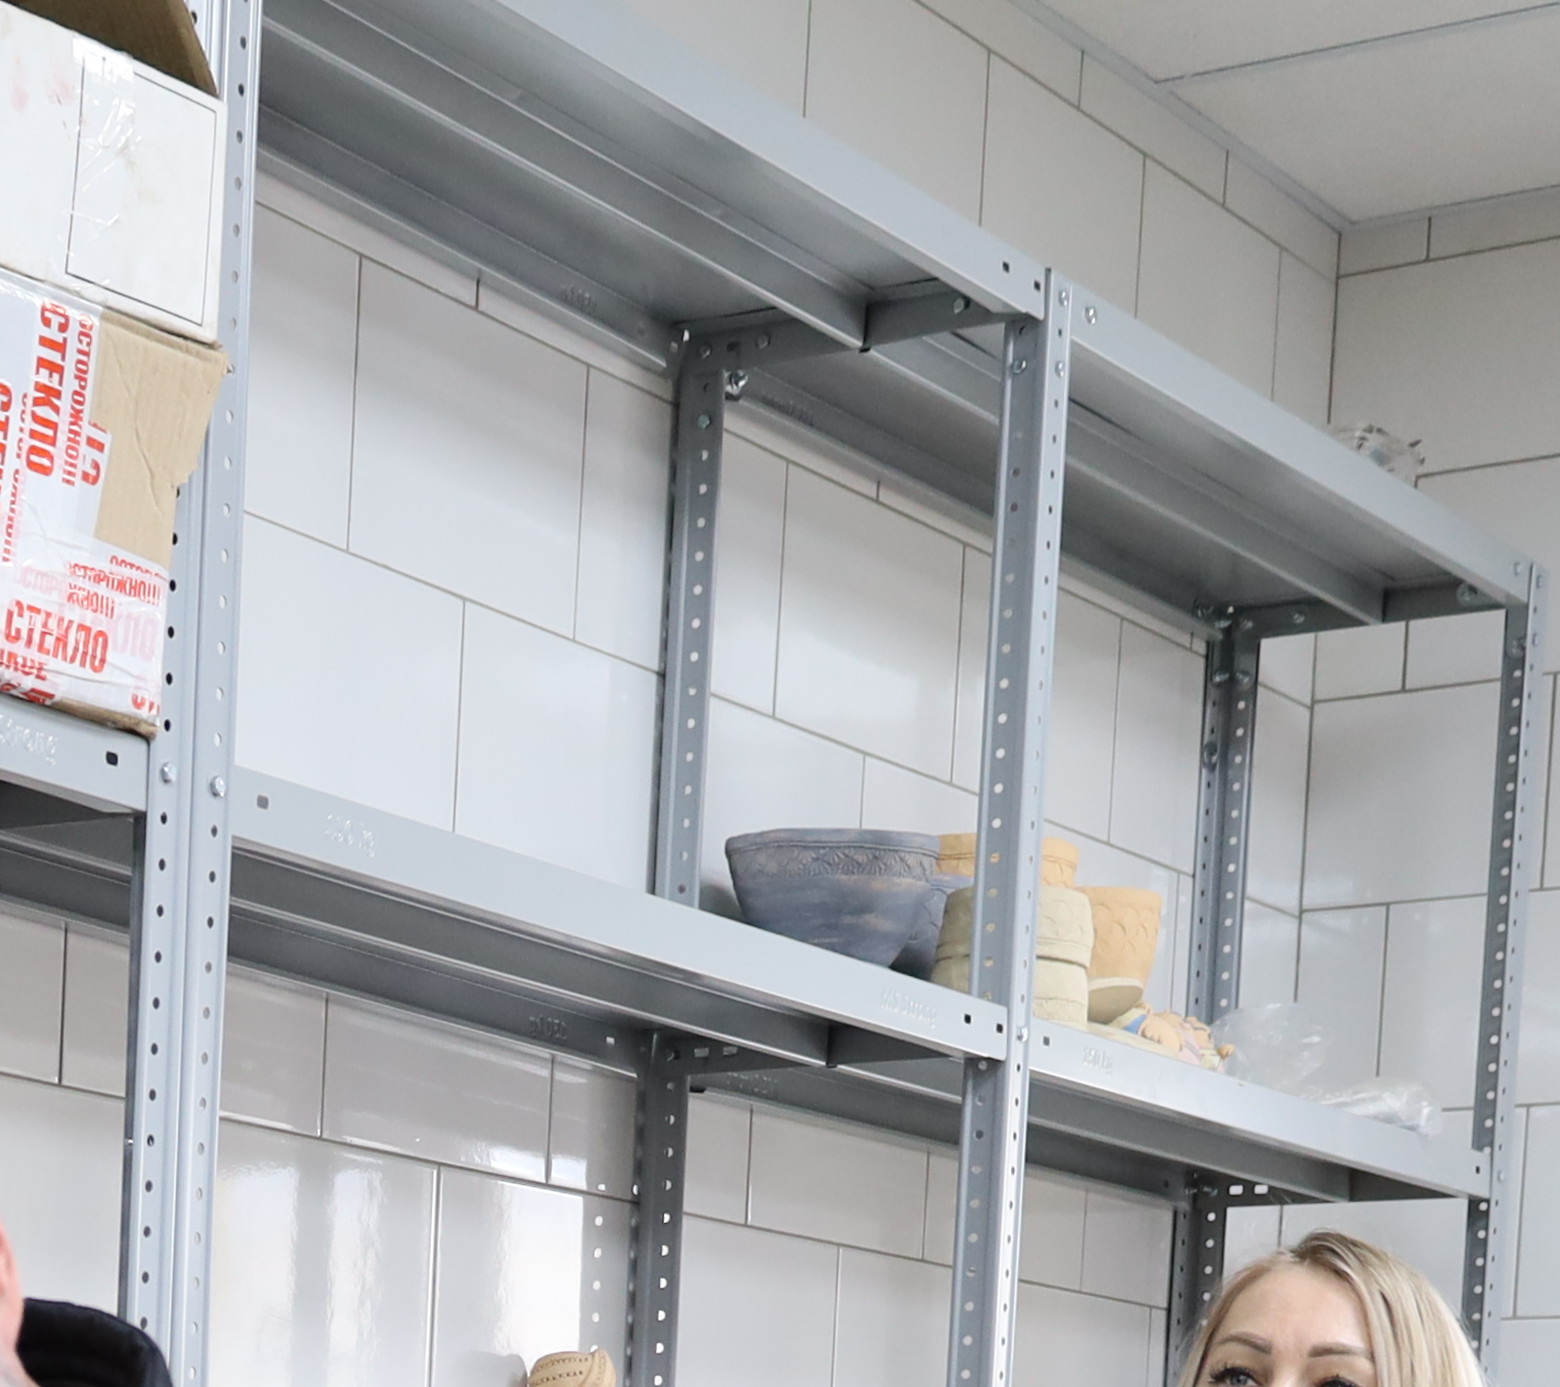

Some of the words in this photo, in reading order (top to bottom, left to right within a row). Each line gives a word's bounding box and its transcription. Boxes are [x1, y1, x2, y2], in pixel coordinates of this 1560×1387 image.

[25, 299, 70, 477] СТЕКЛО
[61, 313, 94, 487] ОСТОРОЖНО!!!
[4, 599, 109, 674] СТЕКЛО
